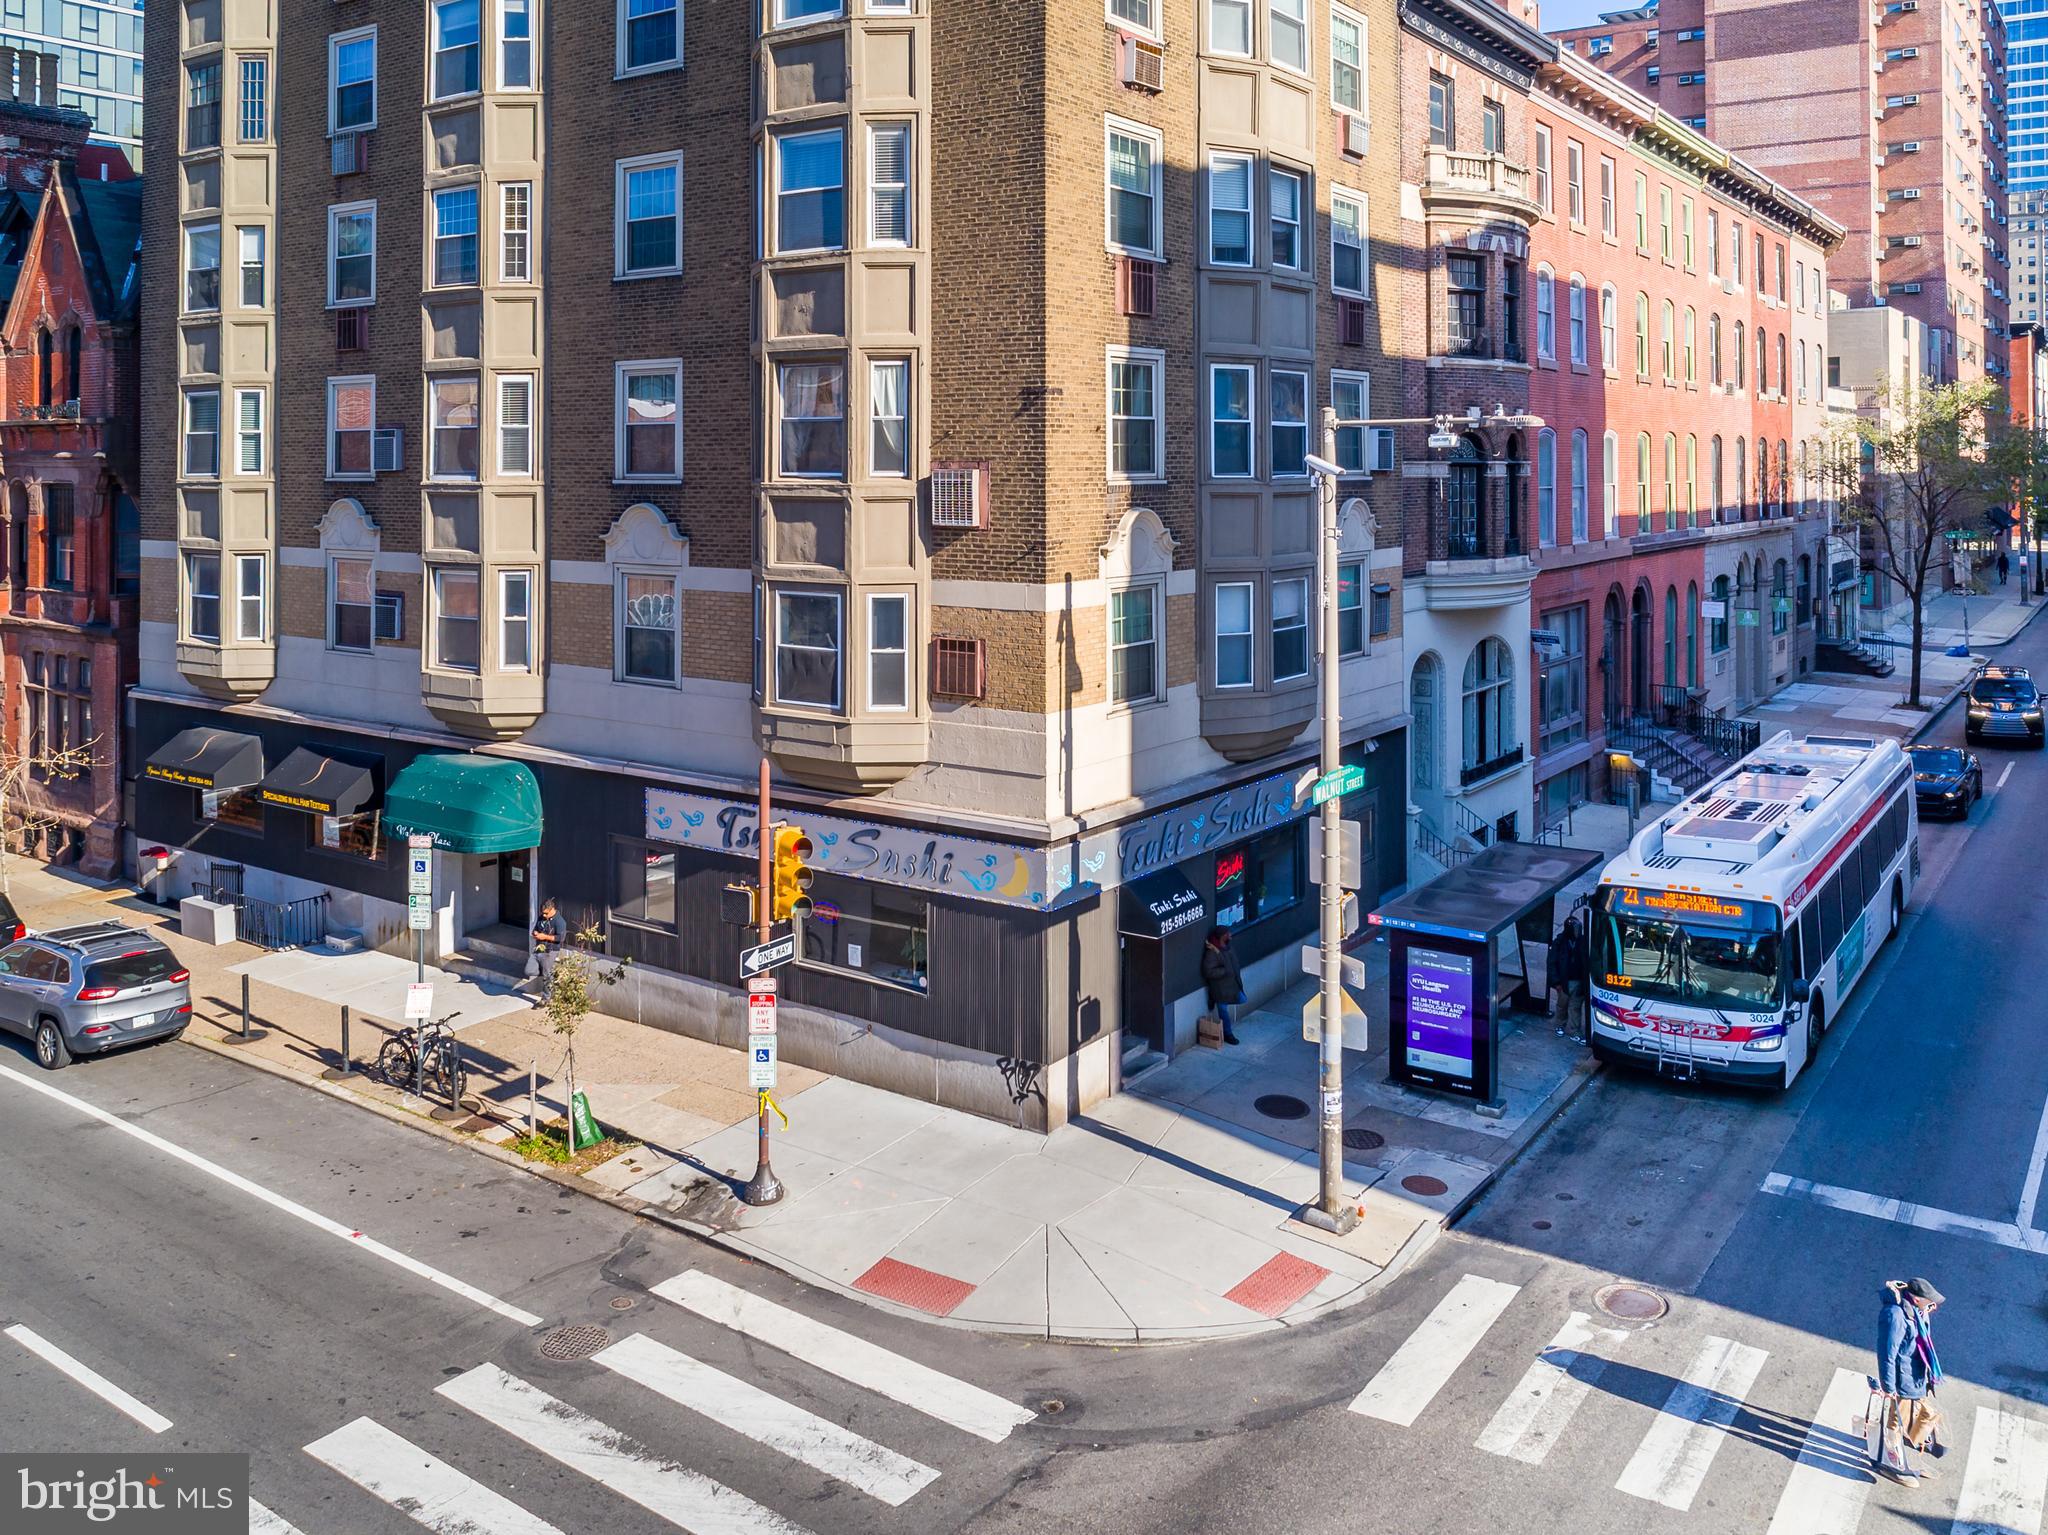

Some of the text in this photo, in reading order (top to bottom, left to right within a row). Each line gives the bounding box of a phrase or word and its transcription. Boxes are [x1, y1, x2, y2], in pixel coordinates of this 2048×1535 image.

[1315, 775, 1363, 803] WALNUT STREET
[428, 831, 452, 847] Plaza
[1118, 787, 1272, 880] Tsuki Sushi
[846, 828, 954, 885] Sushi
[1215, 854, 1244, 887] Sushi
[410, 896, 416, 906] 2
[1150, 889, 1198, 917] Tsuki Sushi
[1624, 887, 1639, 905] 21
[1645, 896, 1742, 916] TRANSPORTATION CTR
[1161, 904, 1204, 935] 215-561-6666
[758, 944, 790, 964] ONE WAY
[1412, 977, 1449, 990] NYU Langone
[1422, 985, 1442, 993] Health
[1428, 998, 1440, 1006] THE
[1441, 1000, 1452, 1008] U.S.
[1599, 989, 1619, 1002] 3024
[1412, 1001, 1463, 1015] NEUROLOGY AND
[1750, 1014, 1775, 1024] 3024
